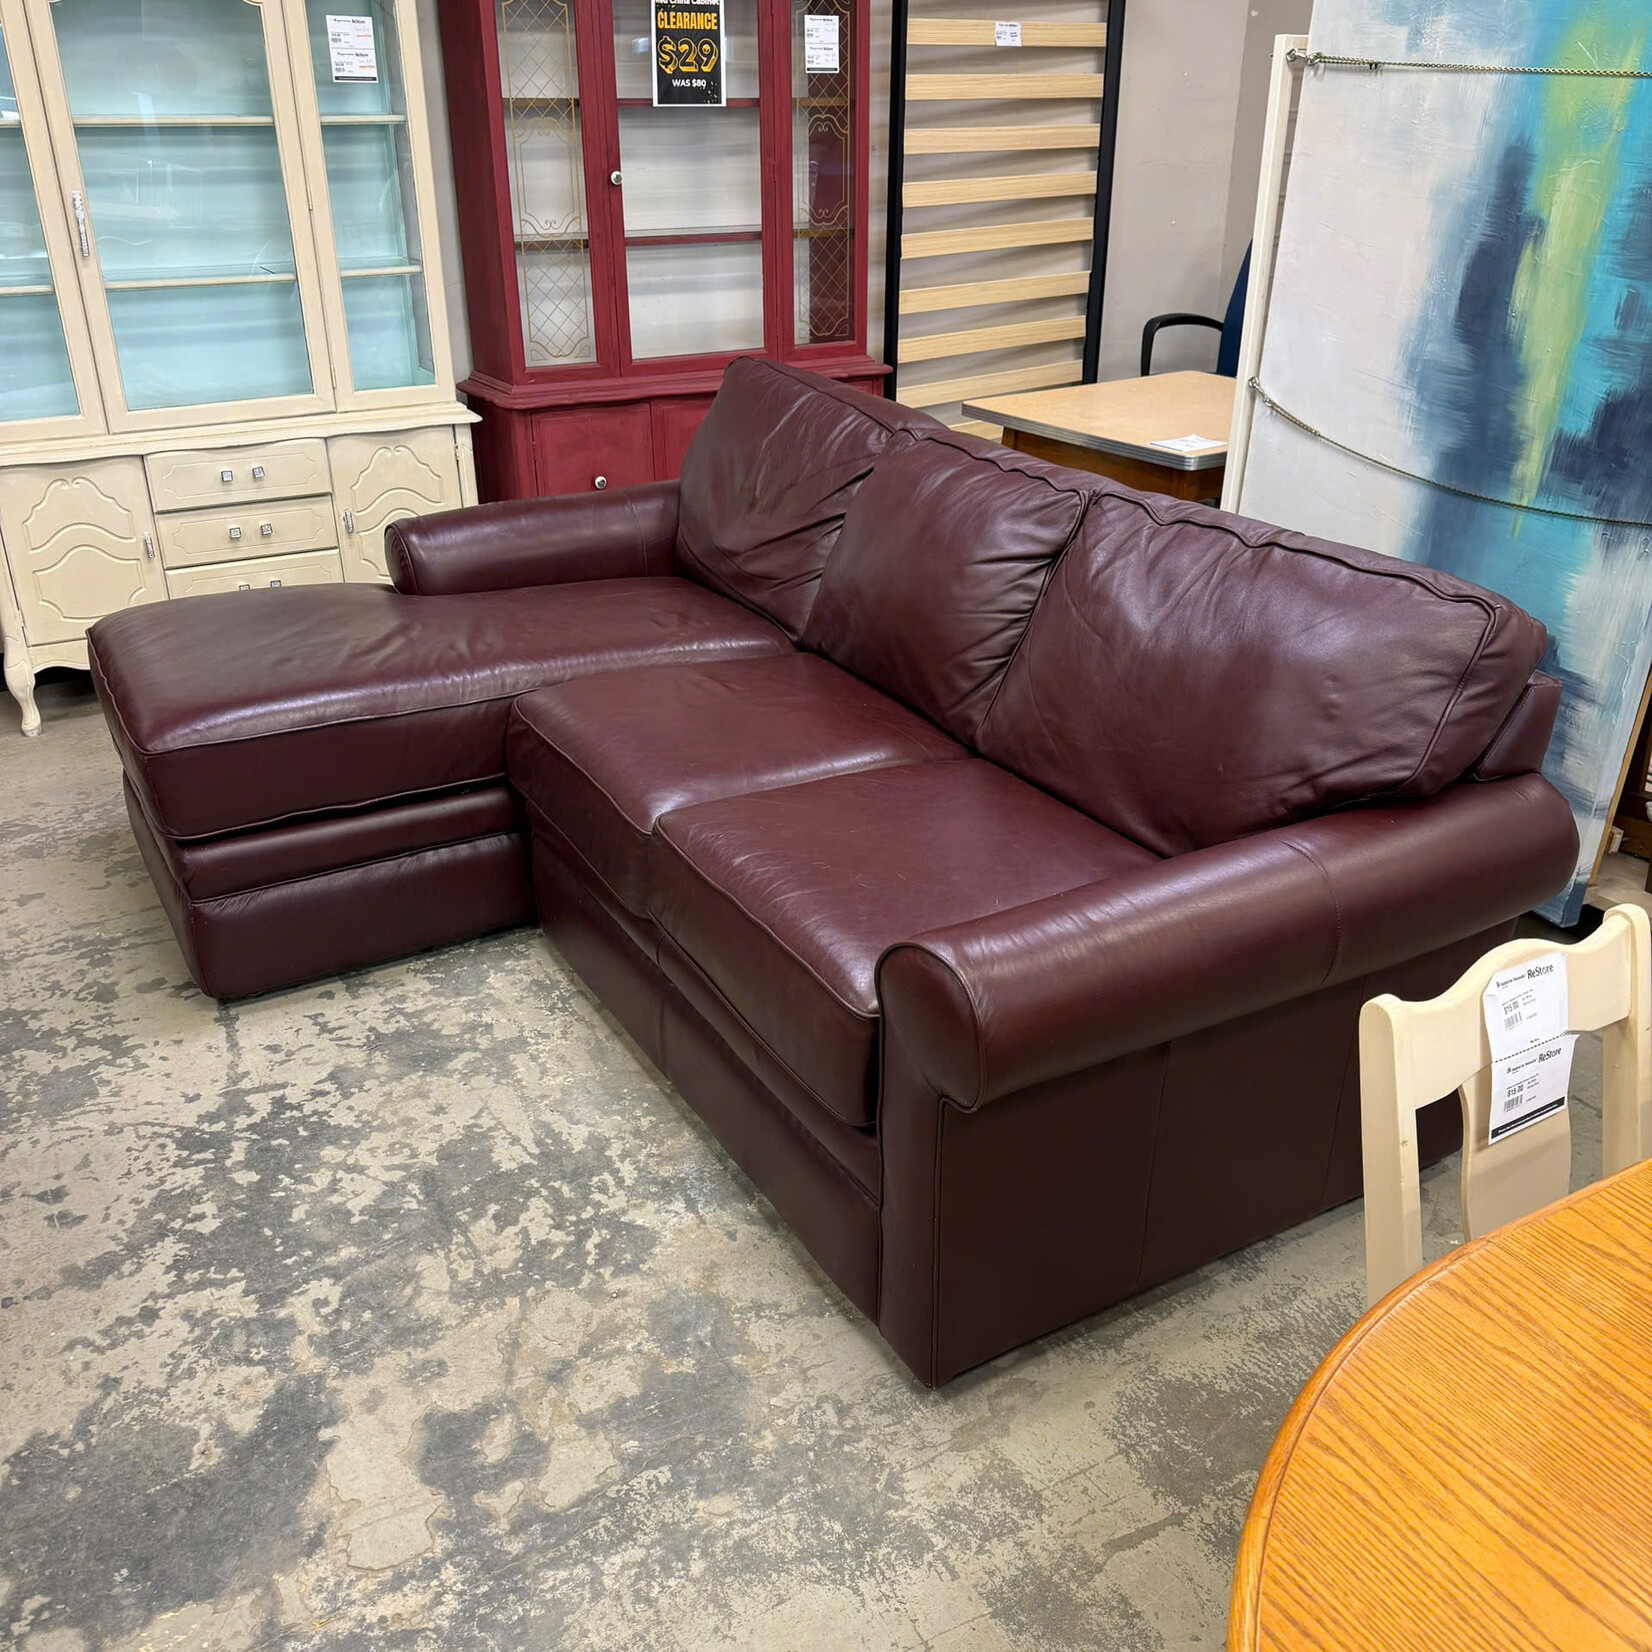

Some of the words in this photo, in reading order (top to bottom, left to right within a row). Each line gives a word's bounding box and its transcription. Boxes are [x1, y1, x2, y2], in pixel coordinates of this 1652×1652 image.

[657, 11, 718, 30] CLEARANCE
[657, 35, 719, 75] $29
[672, 79, 691, 87] WAS
[1526, 964, 1554, 980] ReStore
[1537, 1047, 1562, 1064] ReStore
[1506, 1084, 1524, 1098] $15.00
